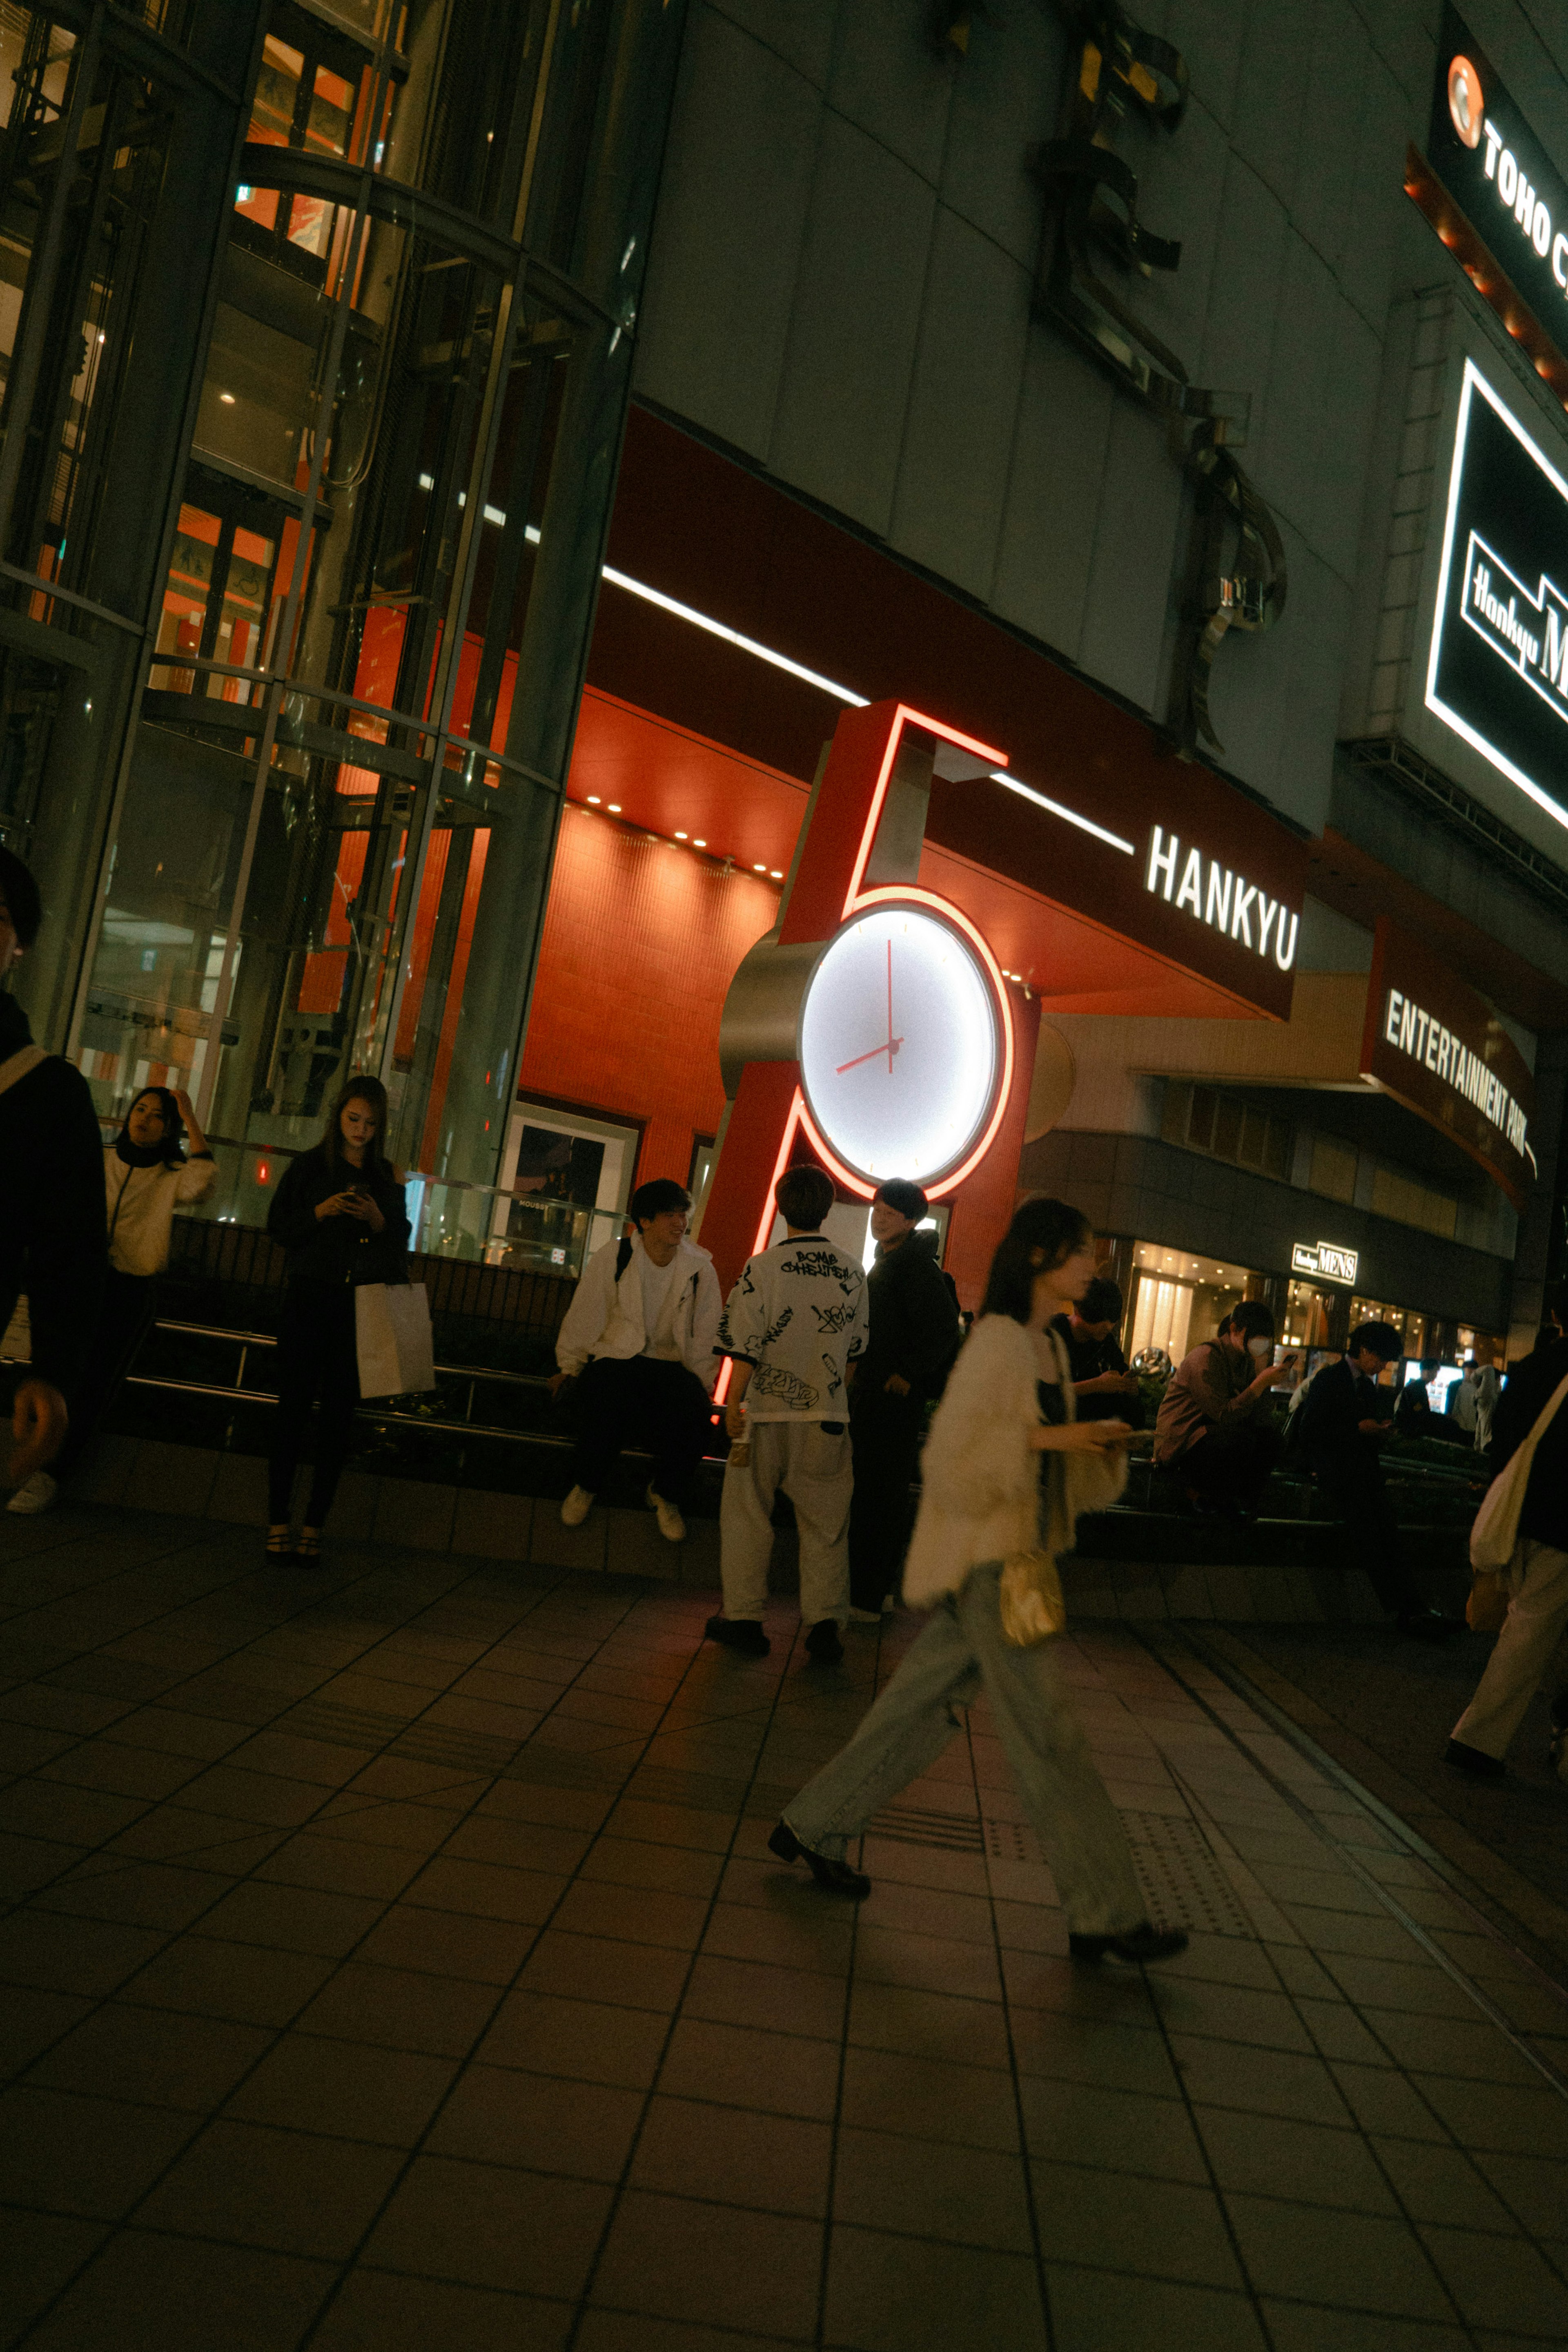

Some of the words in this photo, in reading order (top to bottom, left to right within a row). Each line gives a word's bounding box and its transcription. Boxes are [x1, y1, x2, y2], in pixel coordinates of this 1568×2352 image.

[1484, 118, 1551, 257] TOHO
[1473, 562, 1538, 673] Hankyu
[1147, 824, 1299, 972] HANKYU
[1385, 988, 1508, 1131] ENTERTAINMENT
